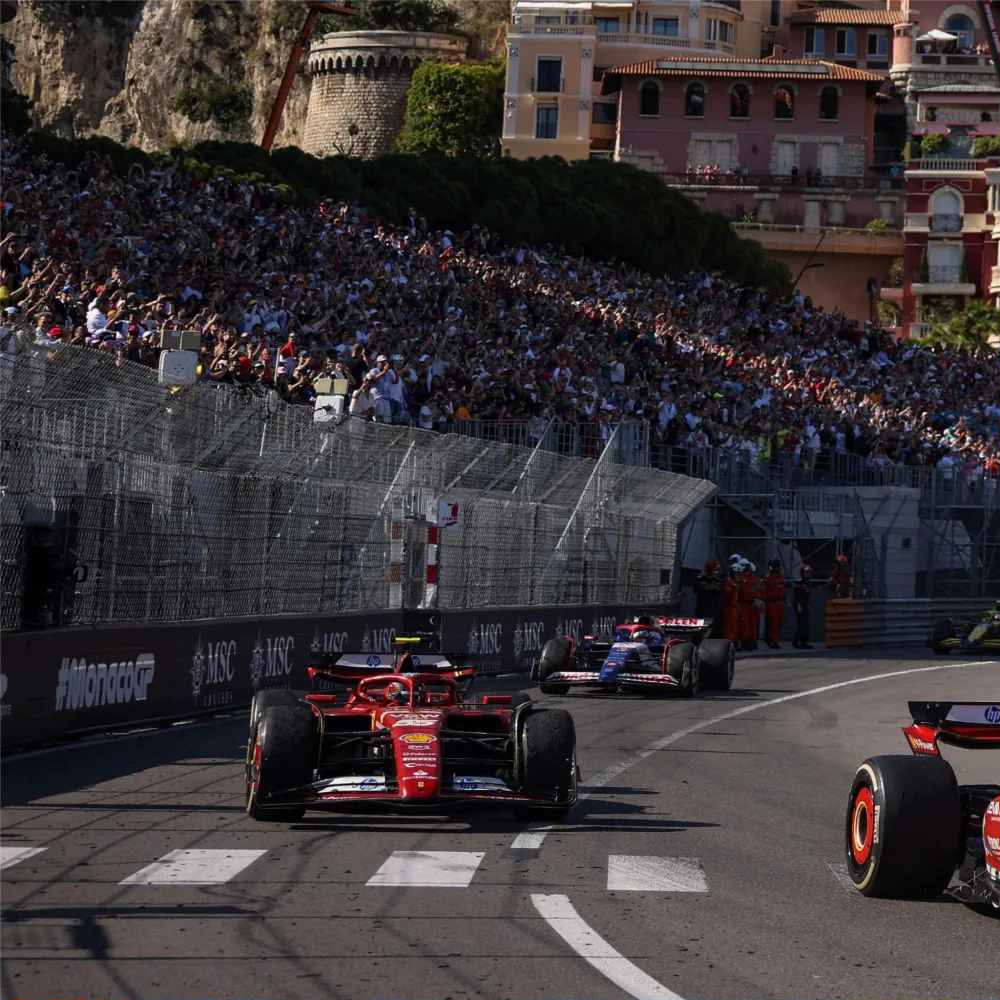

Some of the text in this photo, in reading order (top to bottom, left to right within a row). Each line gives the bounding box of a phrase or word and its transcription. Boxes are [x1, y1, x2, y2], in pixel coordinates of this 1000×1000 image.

[480, 623, 502, 654] MSC
[523, 622, 544, 651] MSC
[565, 619, 583, 646] MSC
[206, 640, 236, 684] MSC
[264, 636, 294, 677] MSC
[367, 655, 380, 667] hp
[55, 653, 155, 711] #MonacoGP
[988, 708, 1000, 723] hp
